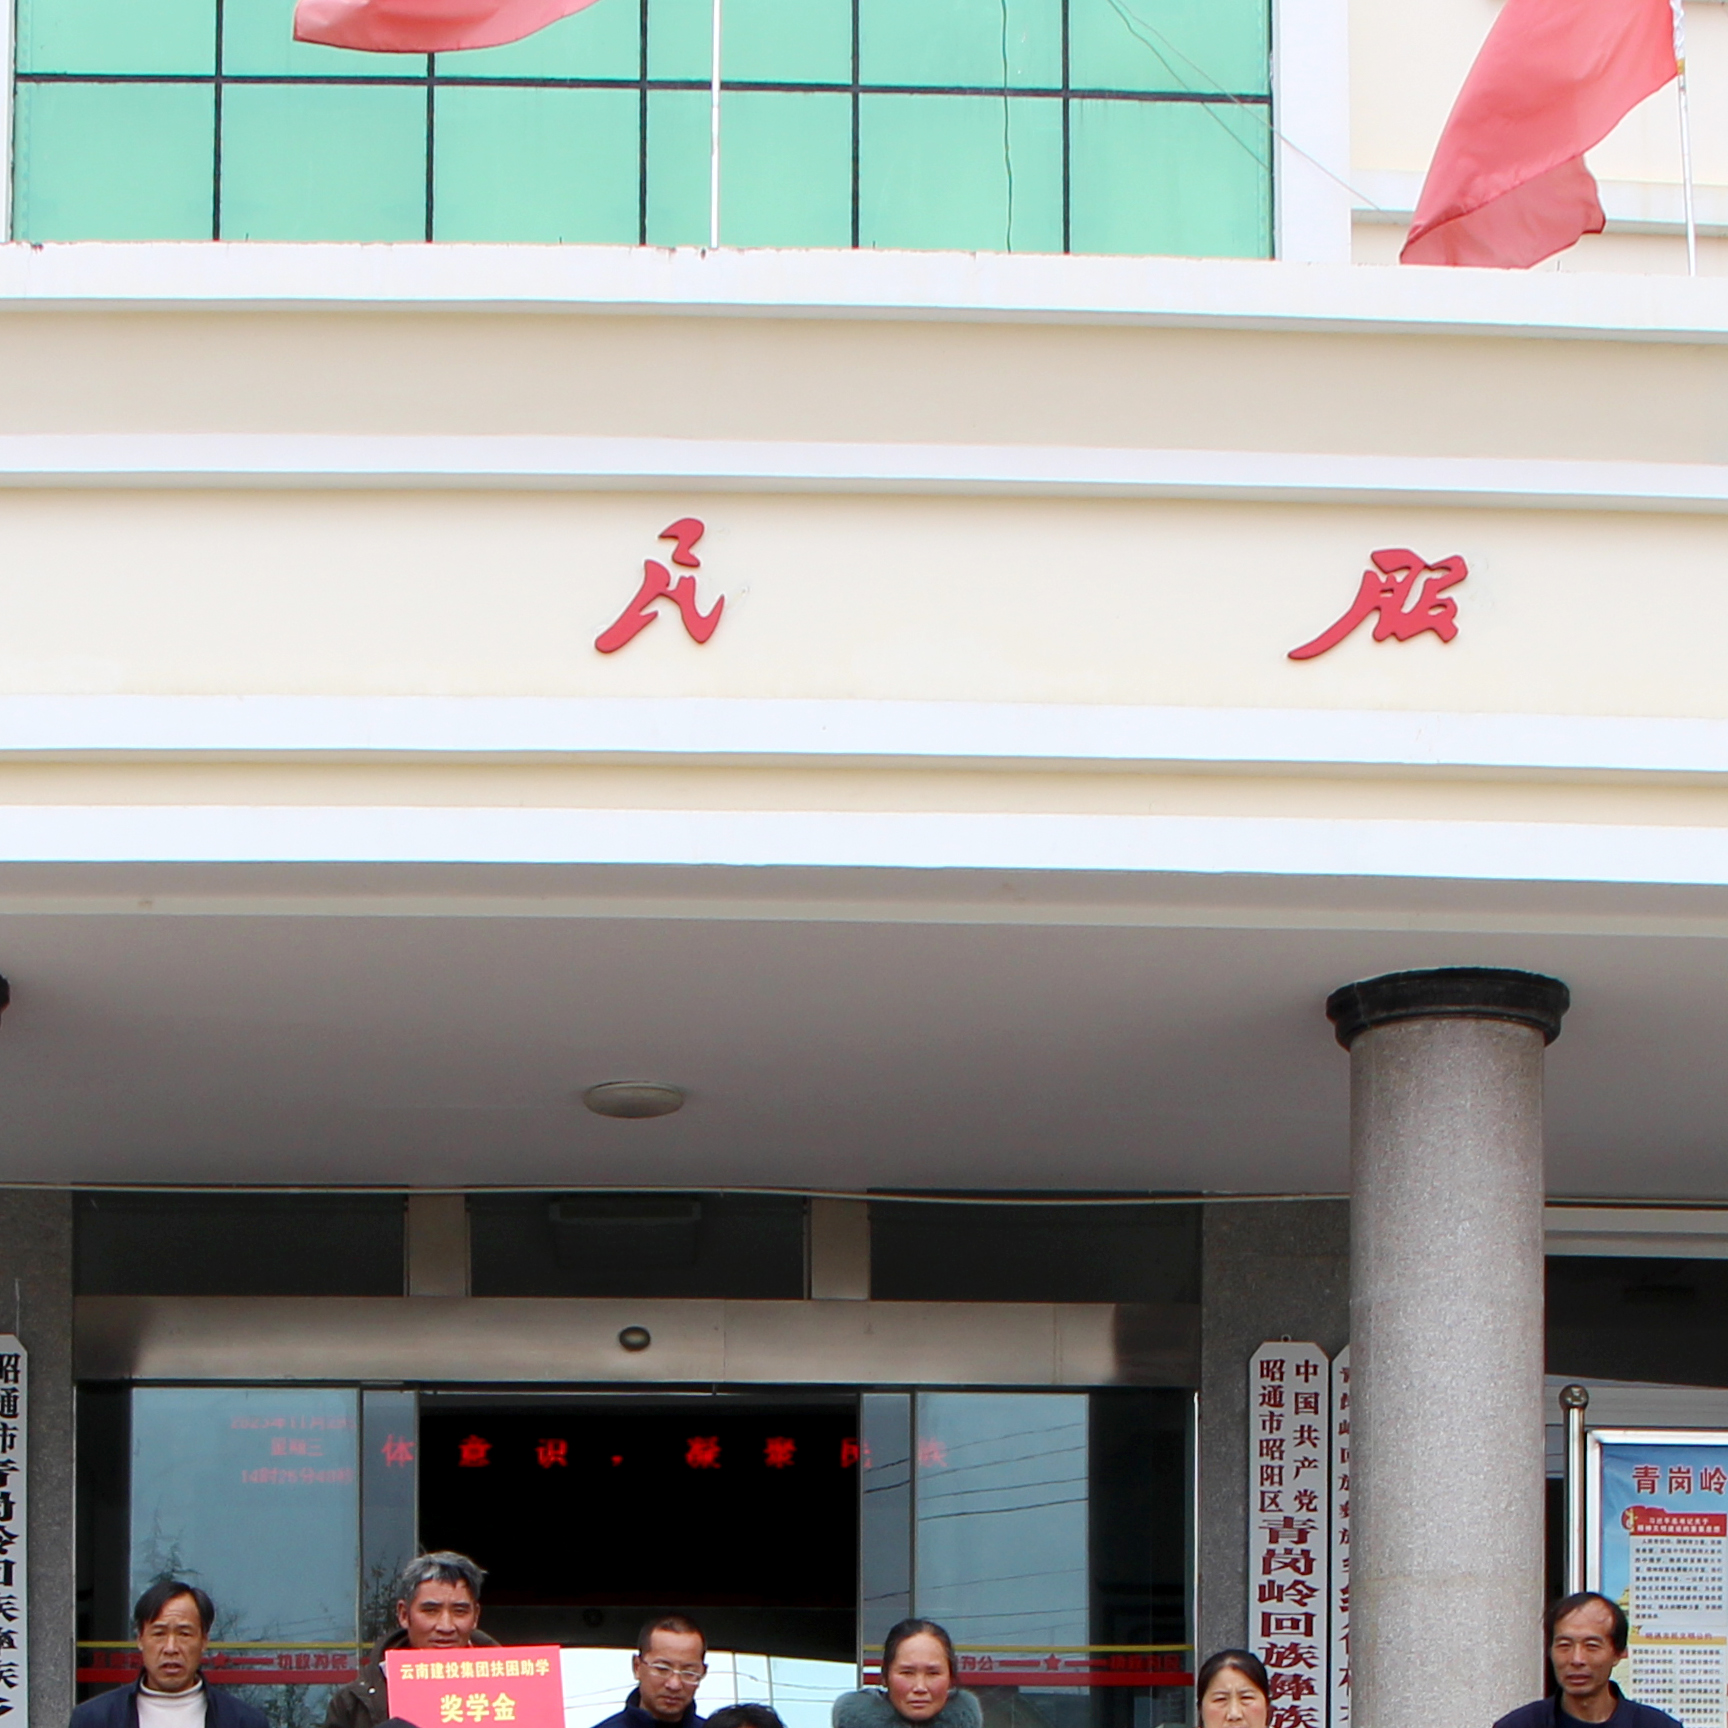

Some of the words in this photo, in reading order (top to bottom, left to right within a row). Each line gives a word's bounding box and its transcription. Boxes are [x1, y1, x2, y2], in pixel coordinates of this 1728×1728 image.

[1258, 1359, 1287, 1513] 昭通市昭阳区
[1293, 1359, 1321, 1513] 中国共产党
[400, 1659, 550, 1681] 云南建投集团扶困助学
[440, 1693, 516, 1723] 奖学金
